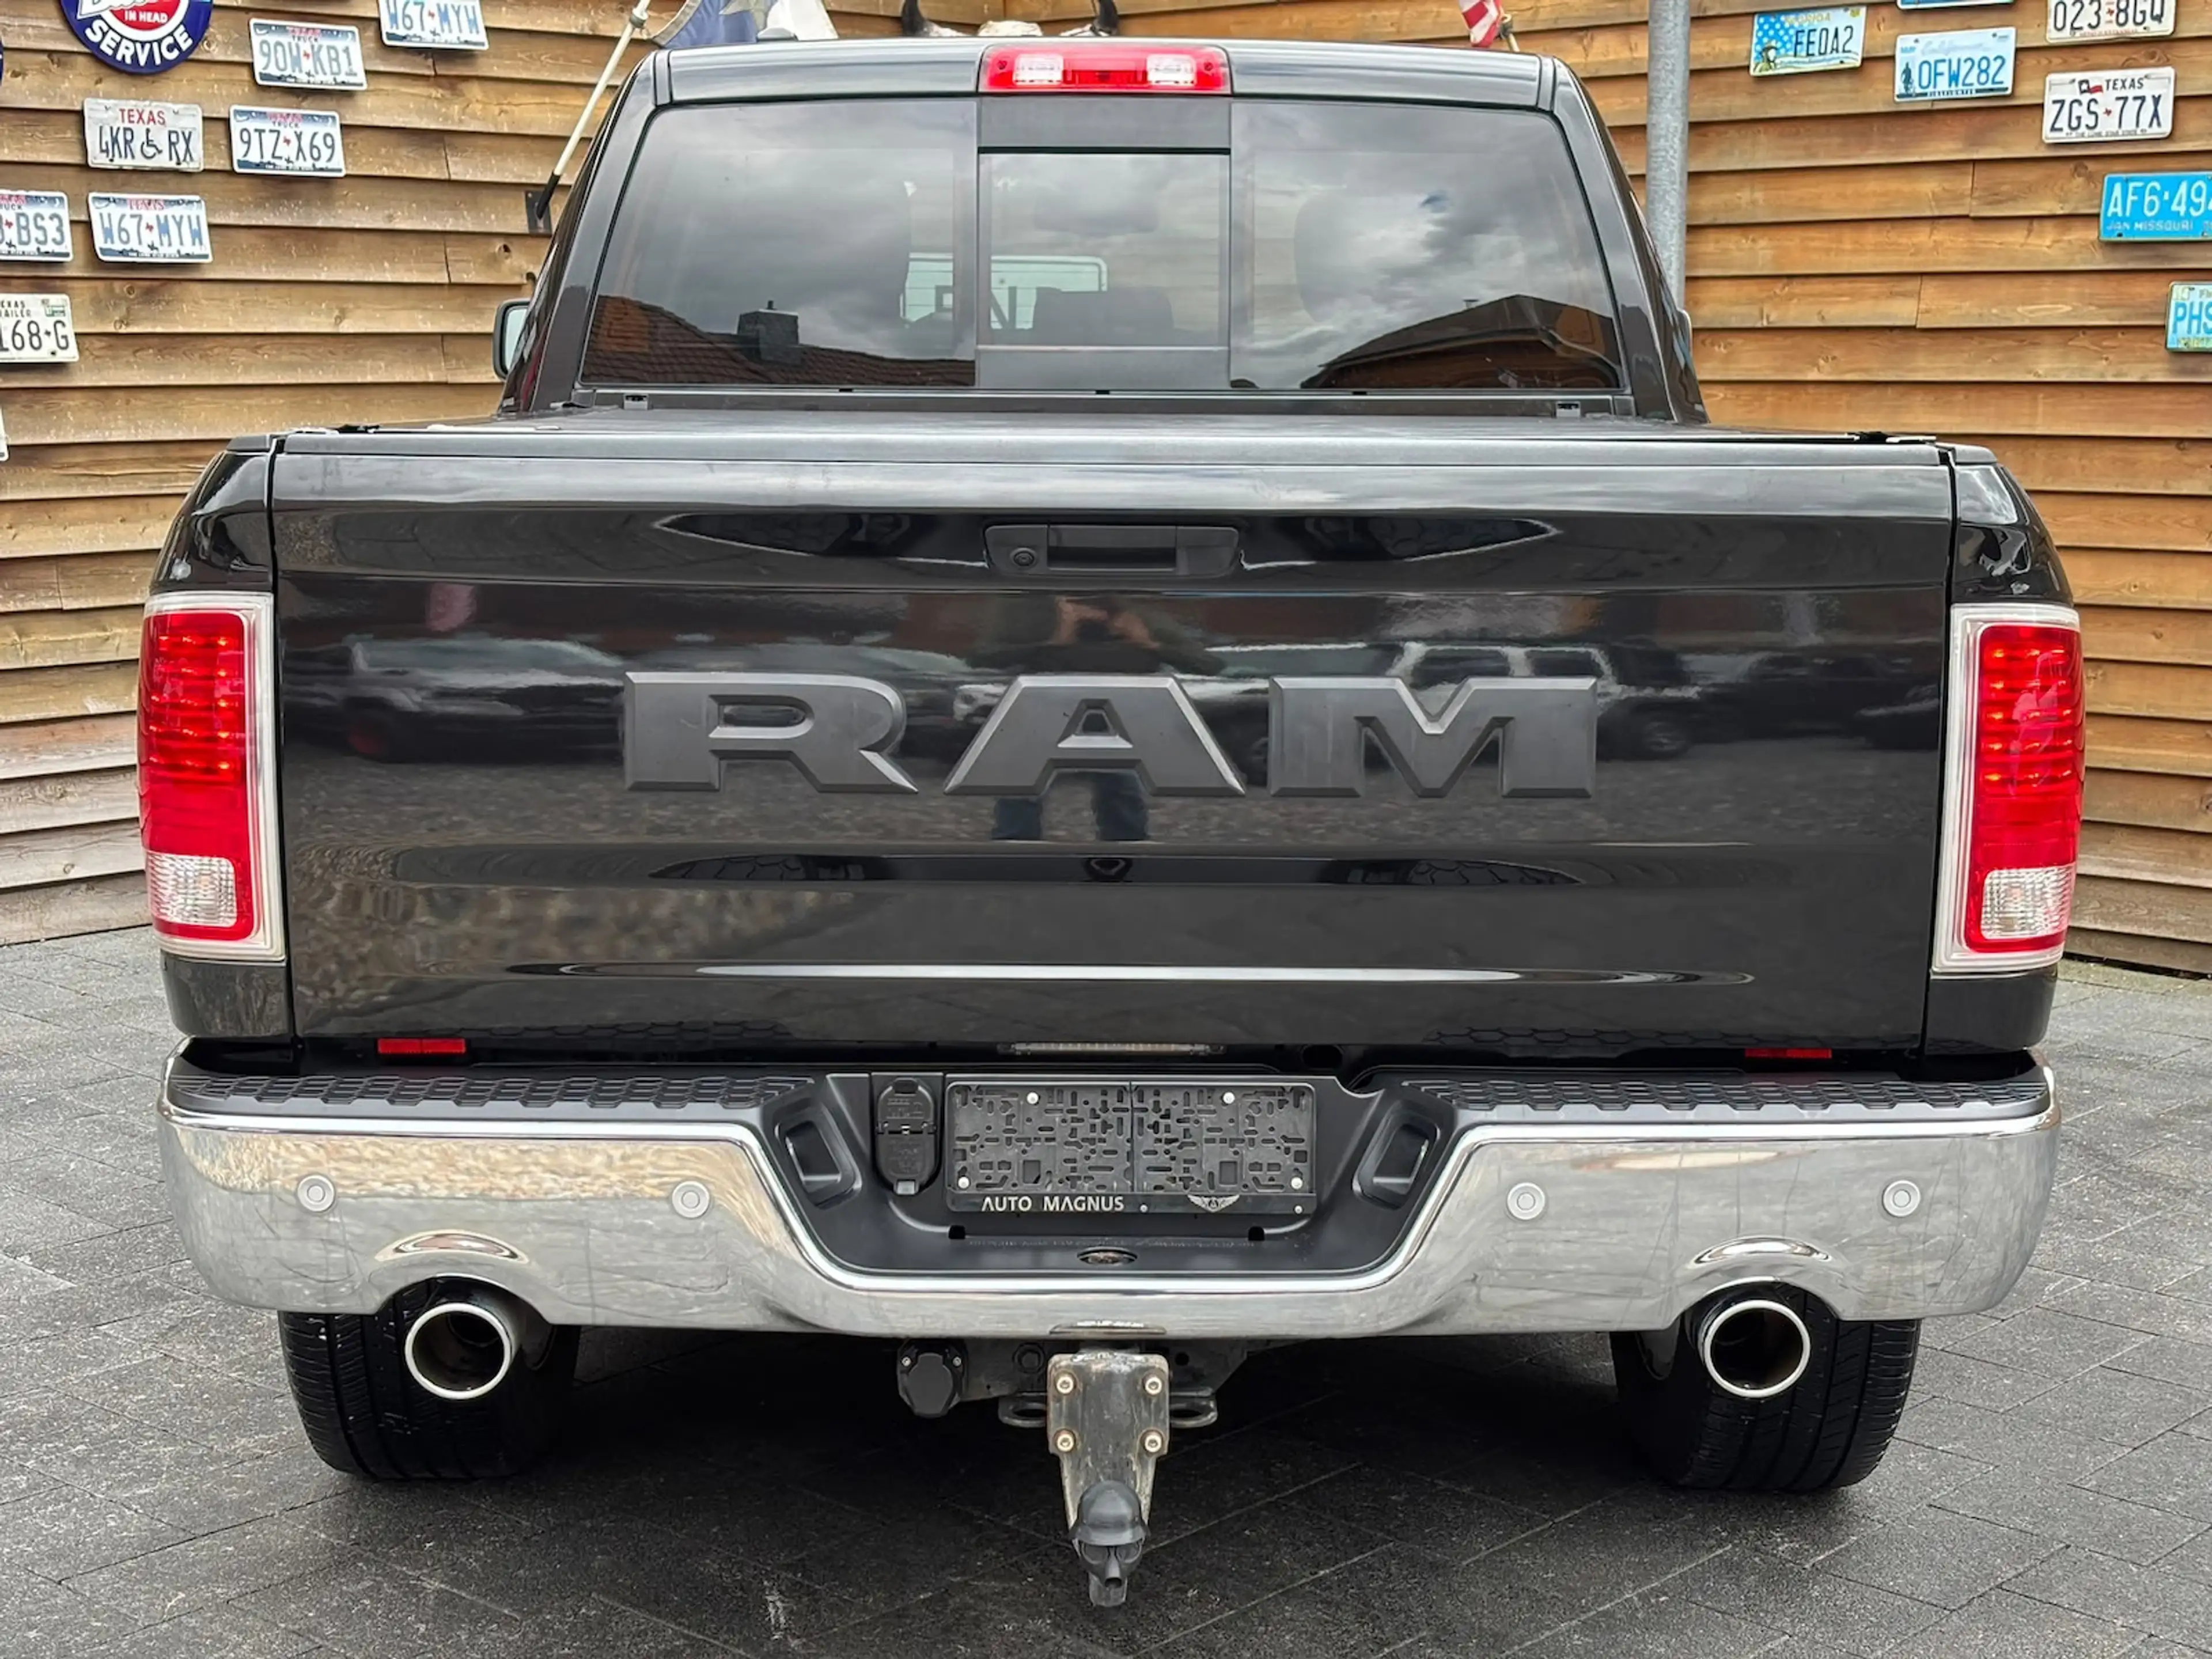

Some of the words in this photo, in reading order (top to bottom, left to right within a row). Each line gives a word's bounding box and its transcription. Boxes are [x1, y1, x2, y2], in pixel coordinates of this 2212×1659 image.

[124, 10, 137, 21] IN
[139, 11, 168, 23] HEAD
[85, 19, 193, 67] SERVICE
[2105, 77, 2145, 91] TEXAS
[119, 108, 166, 125] TEXAS
[168, 130, 194, 162] RX
[2134, 220, 2194, 231] MISSOURI
[624, 671, 1599, 797] RAM
[981, 1196, 1032, 1212] AUTO
[1043, 1195, 1124, 1213] MAGNUS
